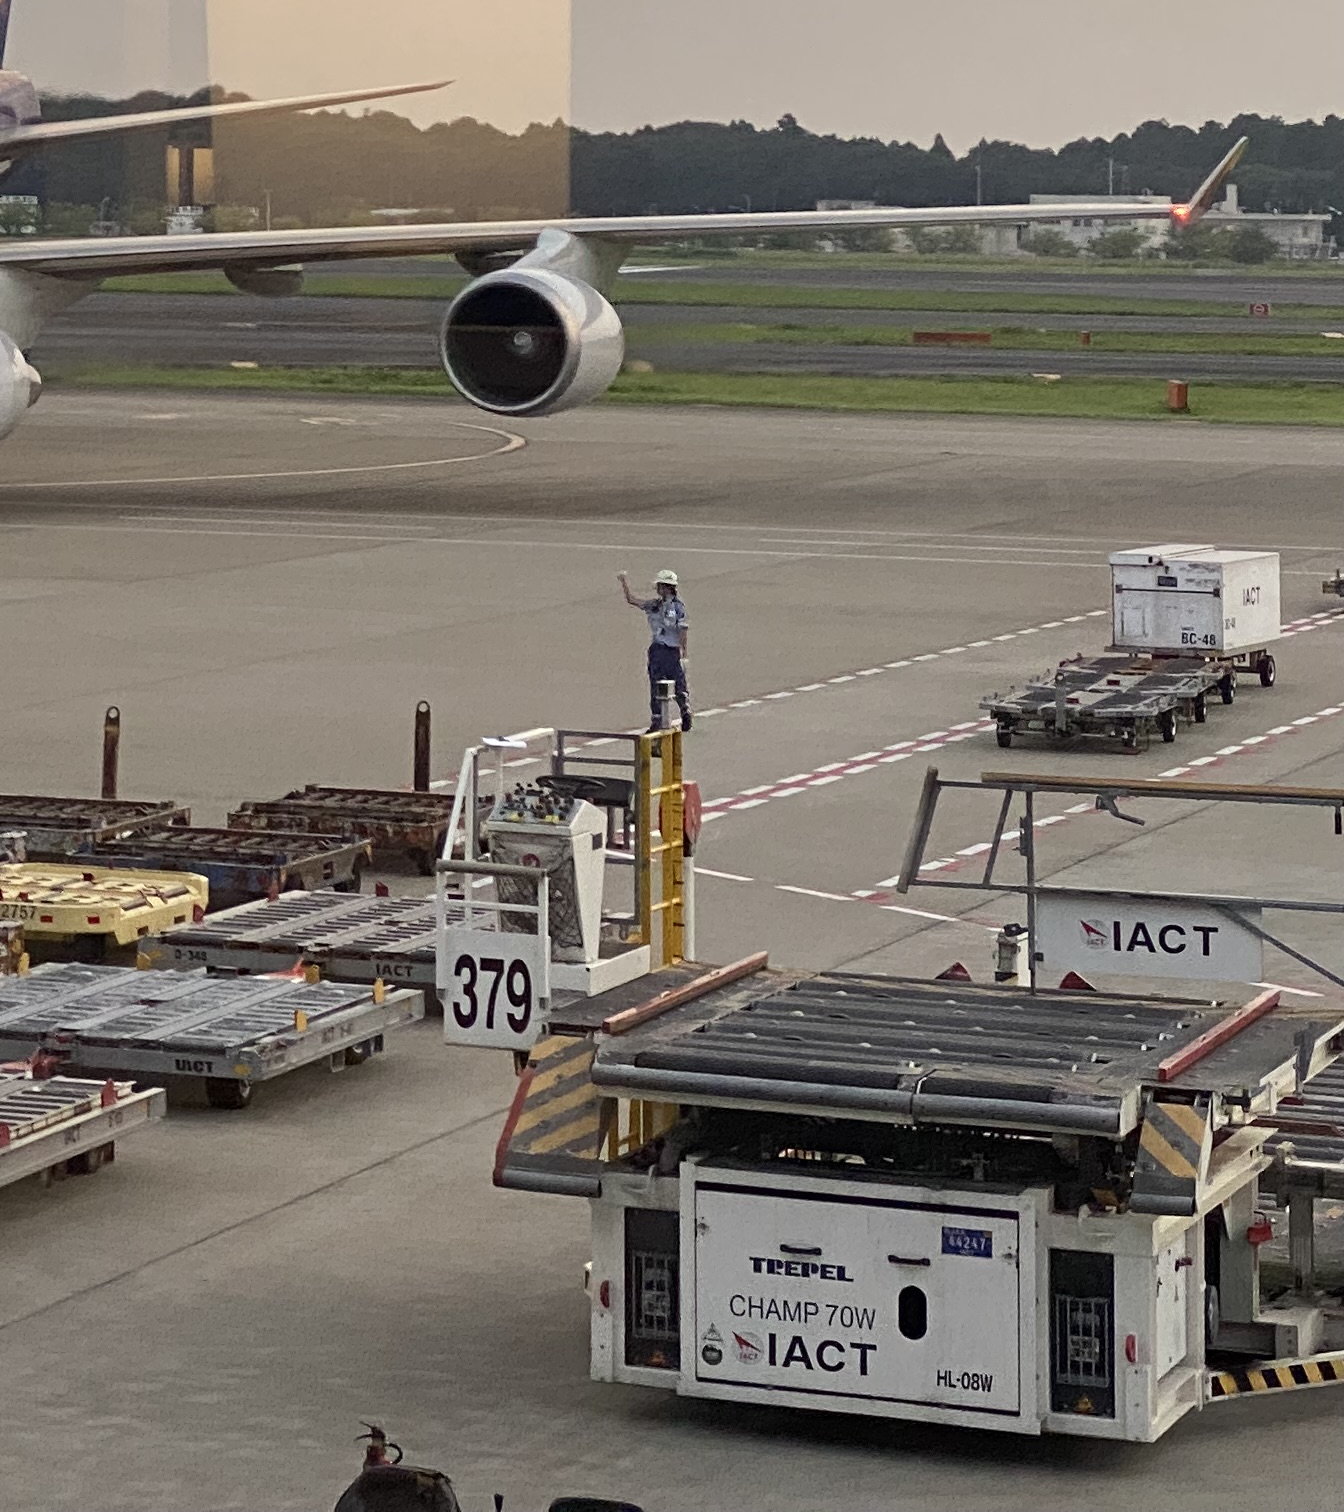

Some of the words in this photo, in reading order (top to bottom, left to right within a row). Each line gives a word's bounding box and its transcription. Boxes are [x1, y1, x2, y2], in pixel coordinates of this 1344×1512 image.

[1242, 587, 1261, 606] IACT
[1181, 632, 1217, 646] BC-48
[1, 904, 37, 919] 2757
[1113, 920, 1219, 956] IACT
[375, 963, 414, 977] IACT
[453, 954, 532, 1034] 379
[749, 1256, 854, 1282] TREPEL
[730, 1294, 819, 1323] CHAMP
[826, 1304, 876, 1331] 70W
[768, 1333, 878, 1376] IACT
[936, 1369, 993, 1393] HL-08W
